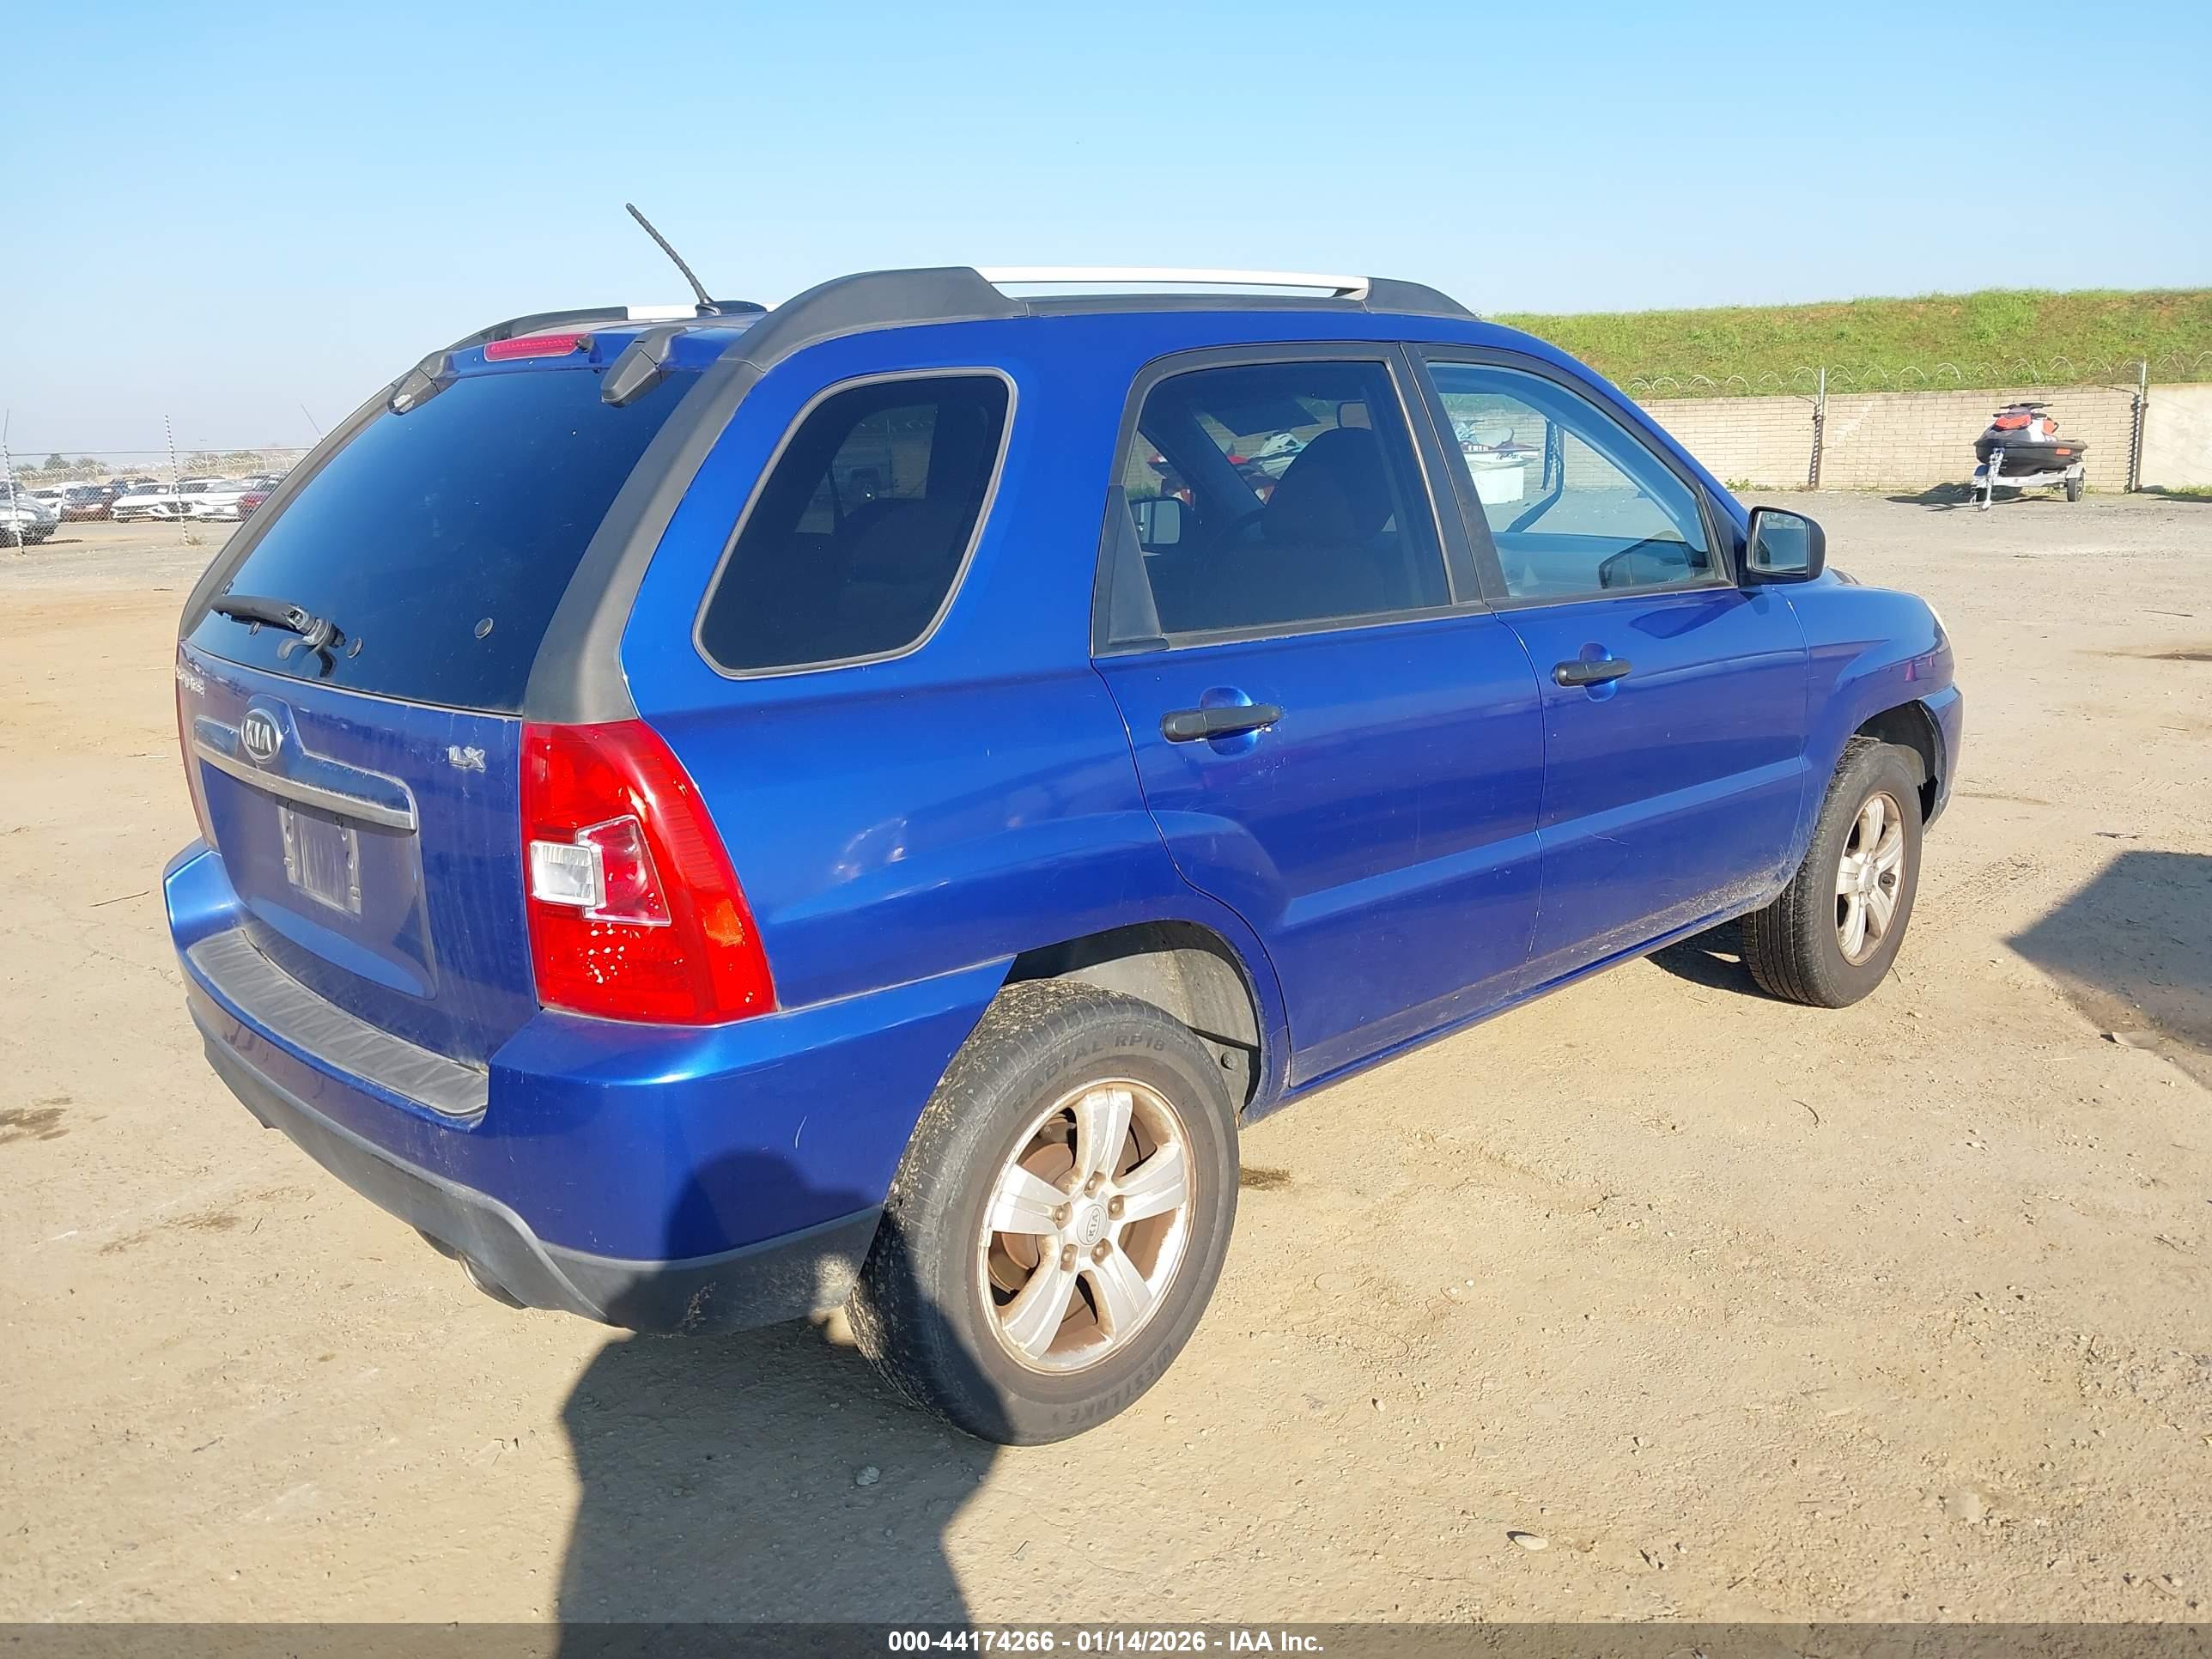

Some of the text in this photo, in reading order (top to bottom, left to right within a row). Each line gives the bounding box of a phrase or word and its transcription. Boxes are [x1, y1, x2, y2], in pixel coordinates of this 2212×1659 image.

[246, 719, 272, 752] KIA
[448, 745, 487, 772] LX
[1114, 1034, 1166, 1051] RP18
[1066, 1342, 1173, 1425] WESTLAKE
